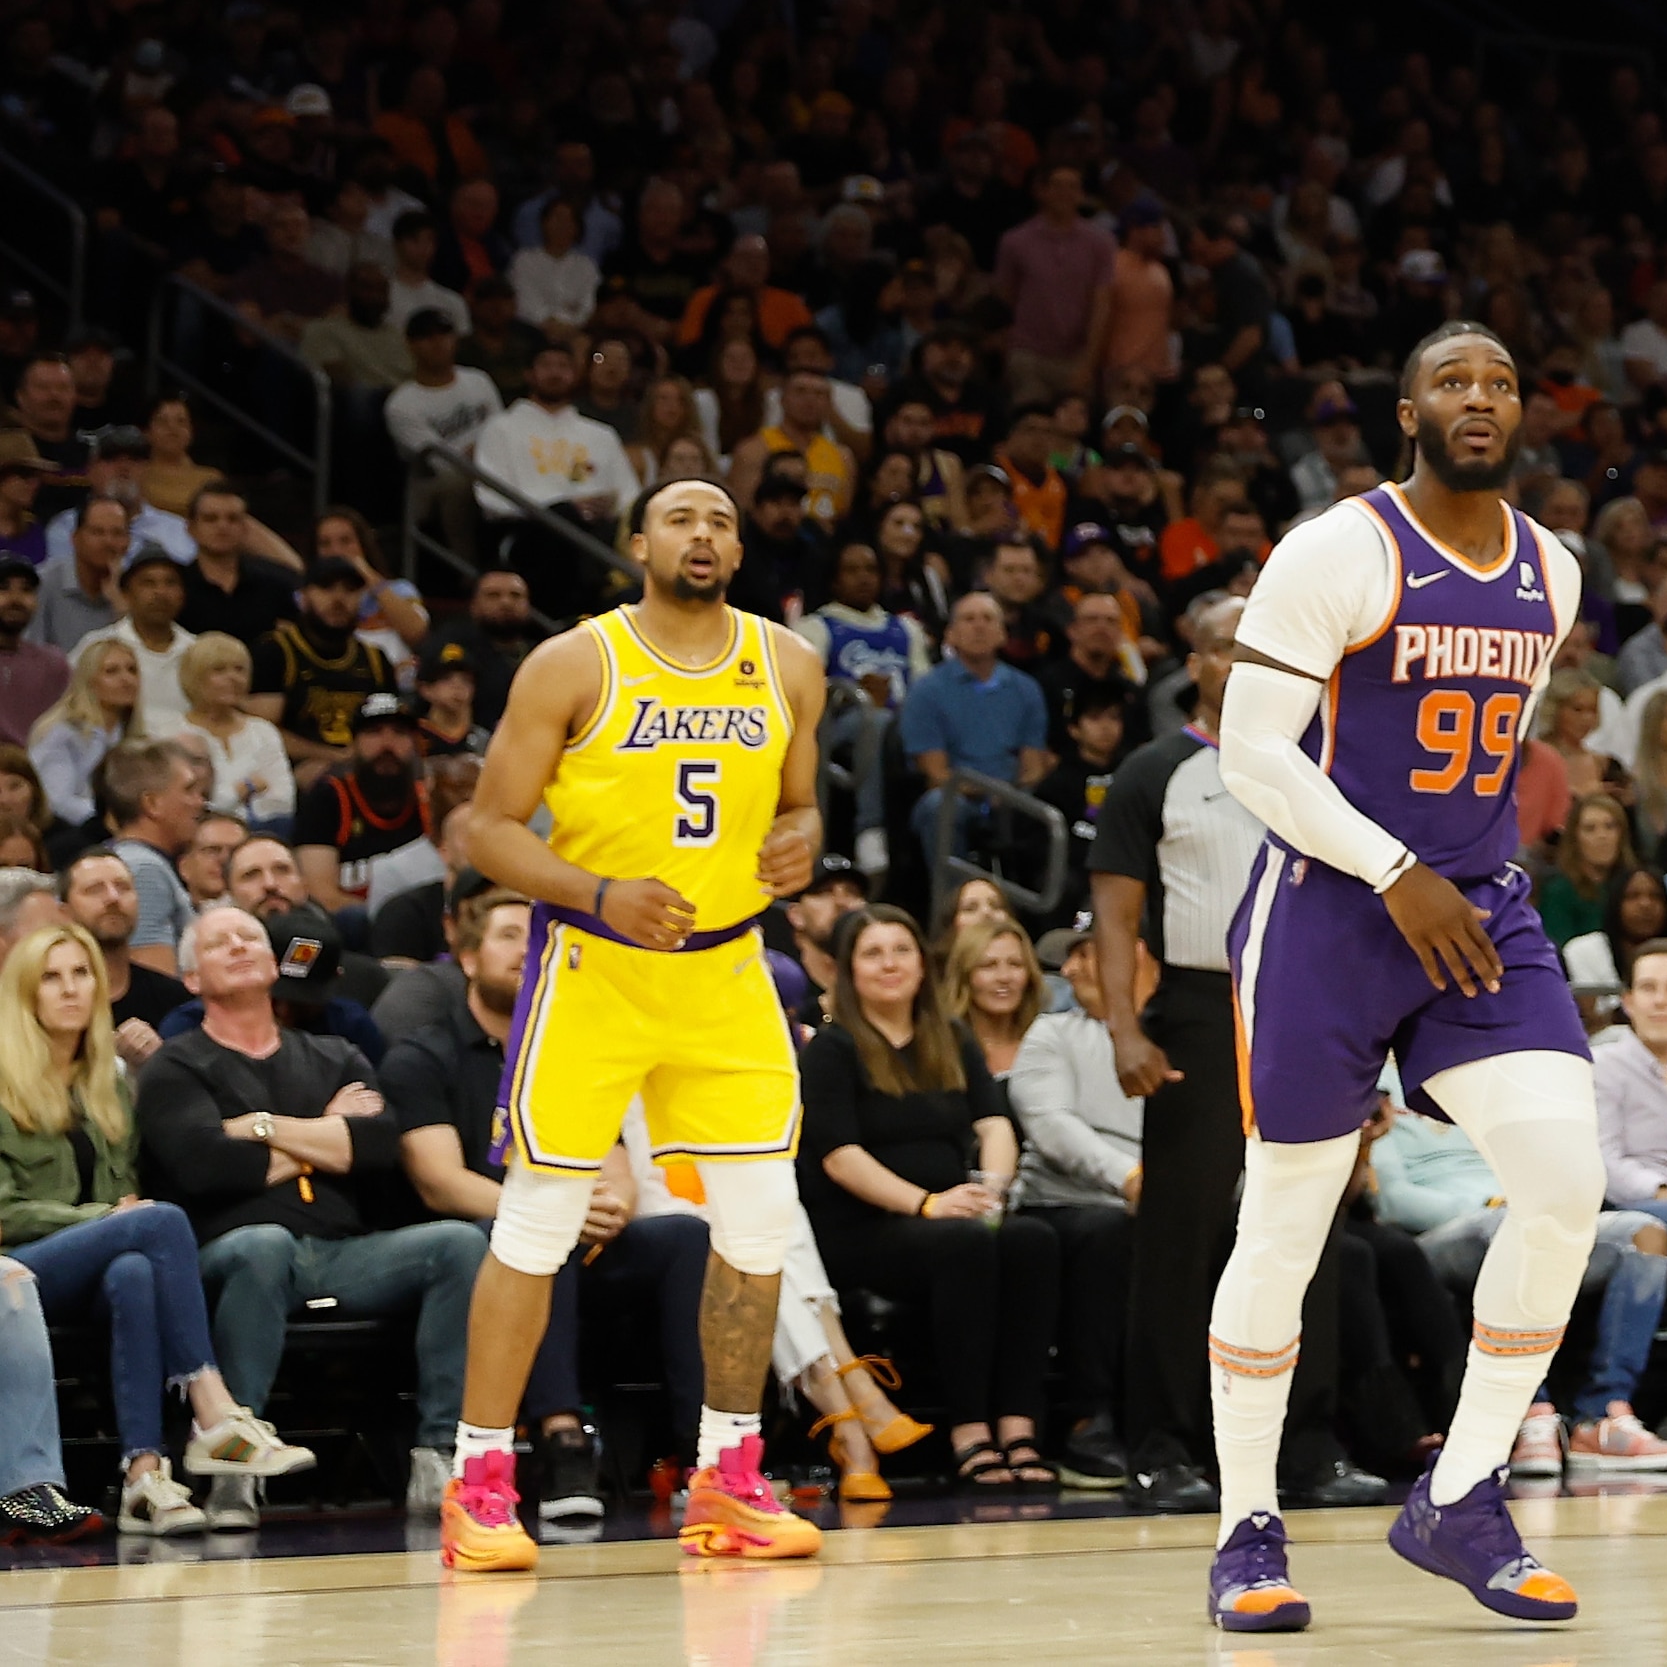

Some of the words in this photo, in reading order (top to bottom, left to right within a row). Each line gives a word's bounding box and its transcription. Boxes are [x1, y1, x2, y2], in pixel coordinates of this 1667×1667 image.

[1391, 623, 1554, 686] PHOENIX
[615, 695, 769, 750] LAKERS
[1409, 688, 1523, 797] 99
[672, 759, 721, 848] 5
